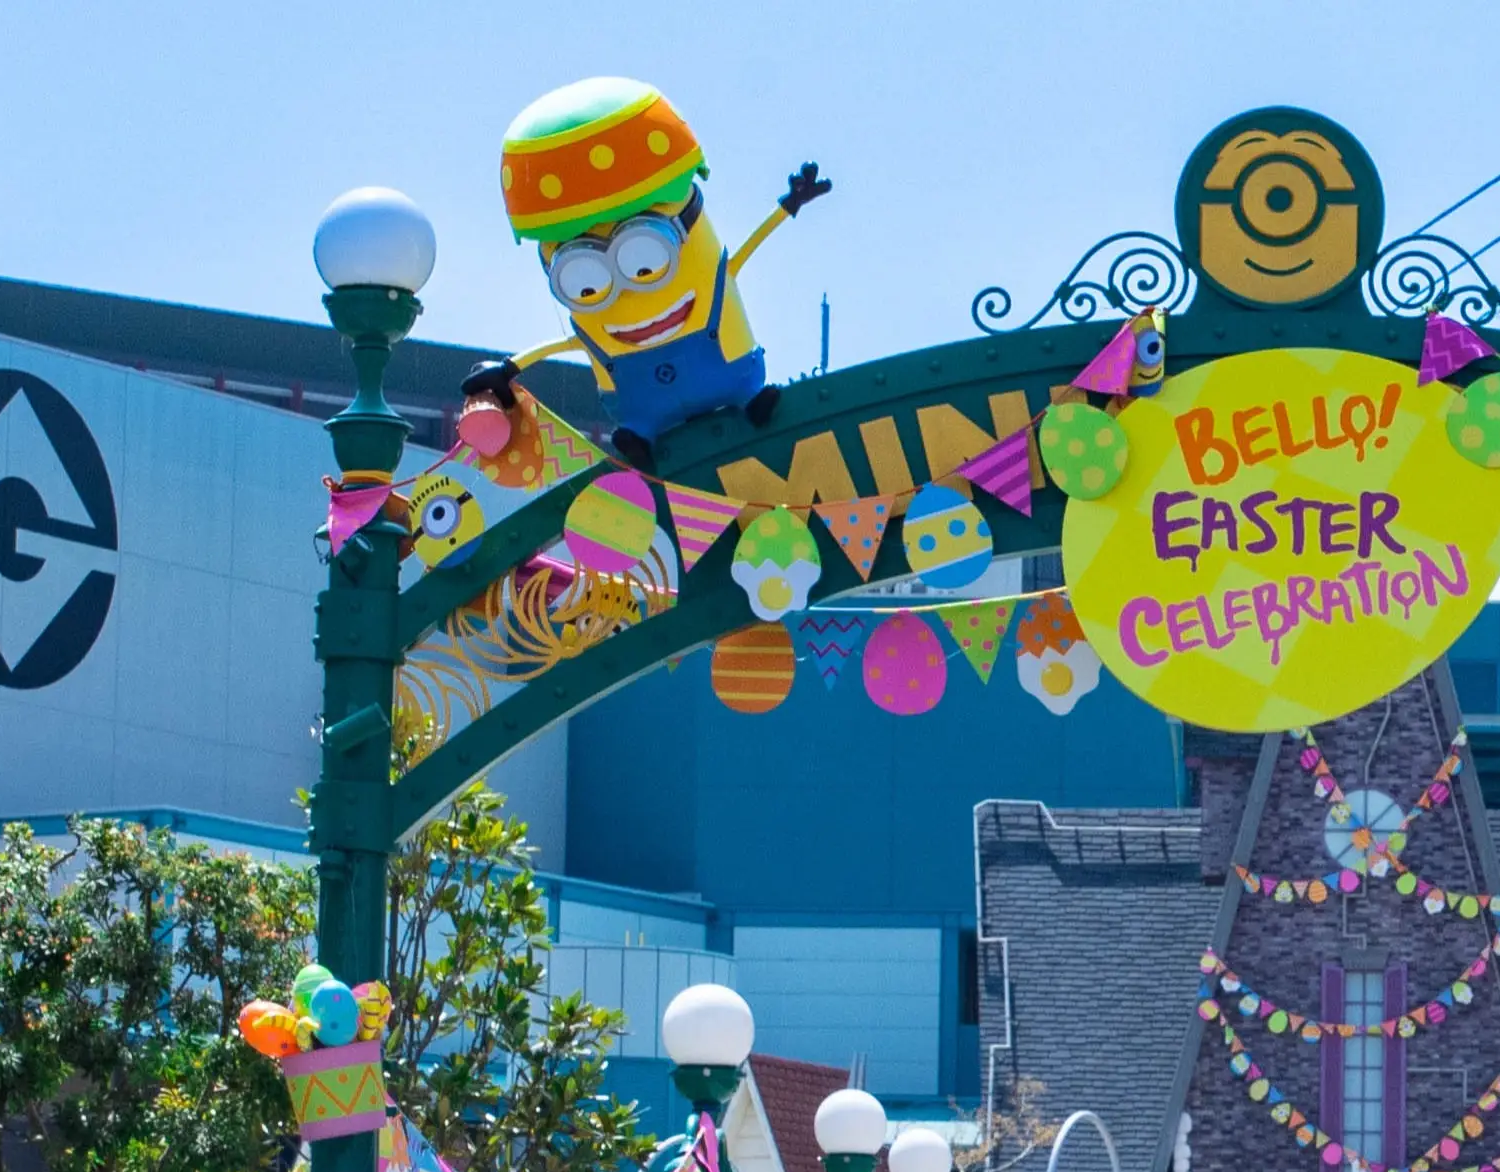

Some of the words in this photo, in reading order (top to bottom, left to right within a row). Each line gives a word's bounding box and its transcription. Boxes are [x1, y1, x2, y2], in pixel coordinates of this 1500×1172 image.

[1174, 383, 1402, 486] BELLO!
[1152, 490, 1406, 573] EASTER
[1119, 543, 1470, 667] CELEBRATION
